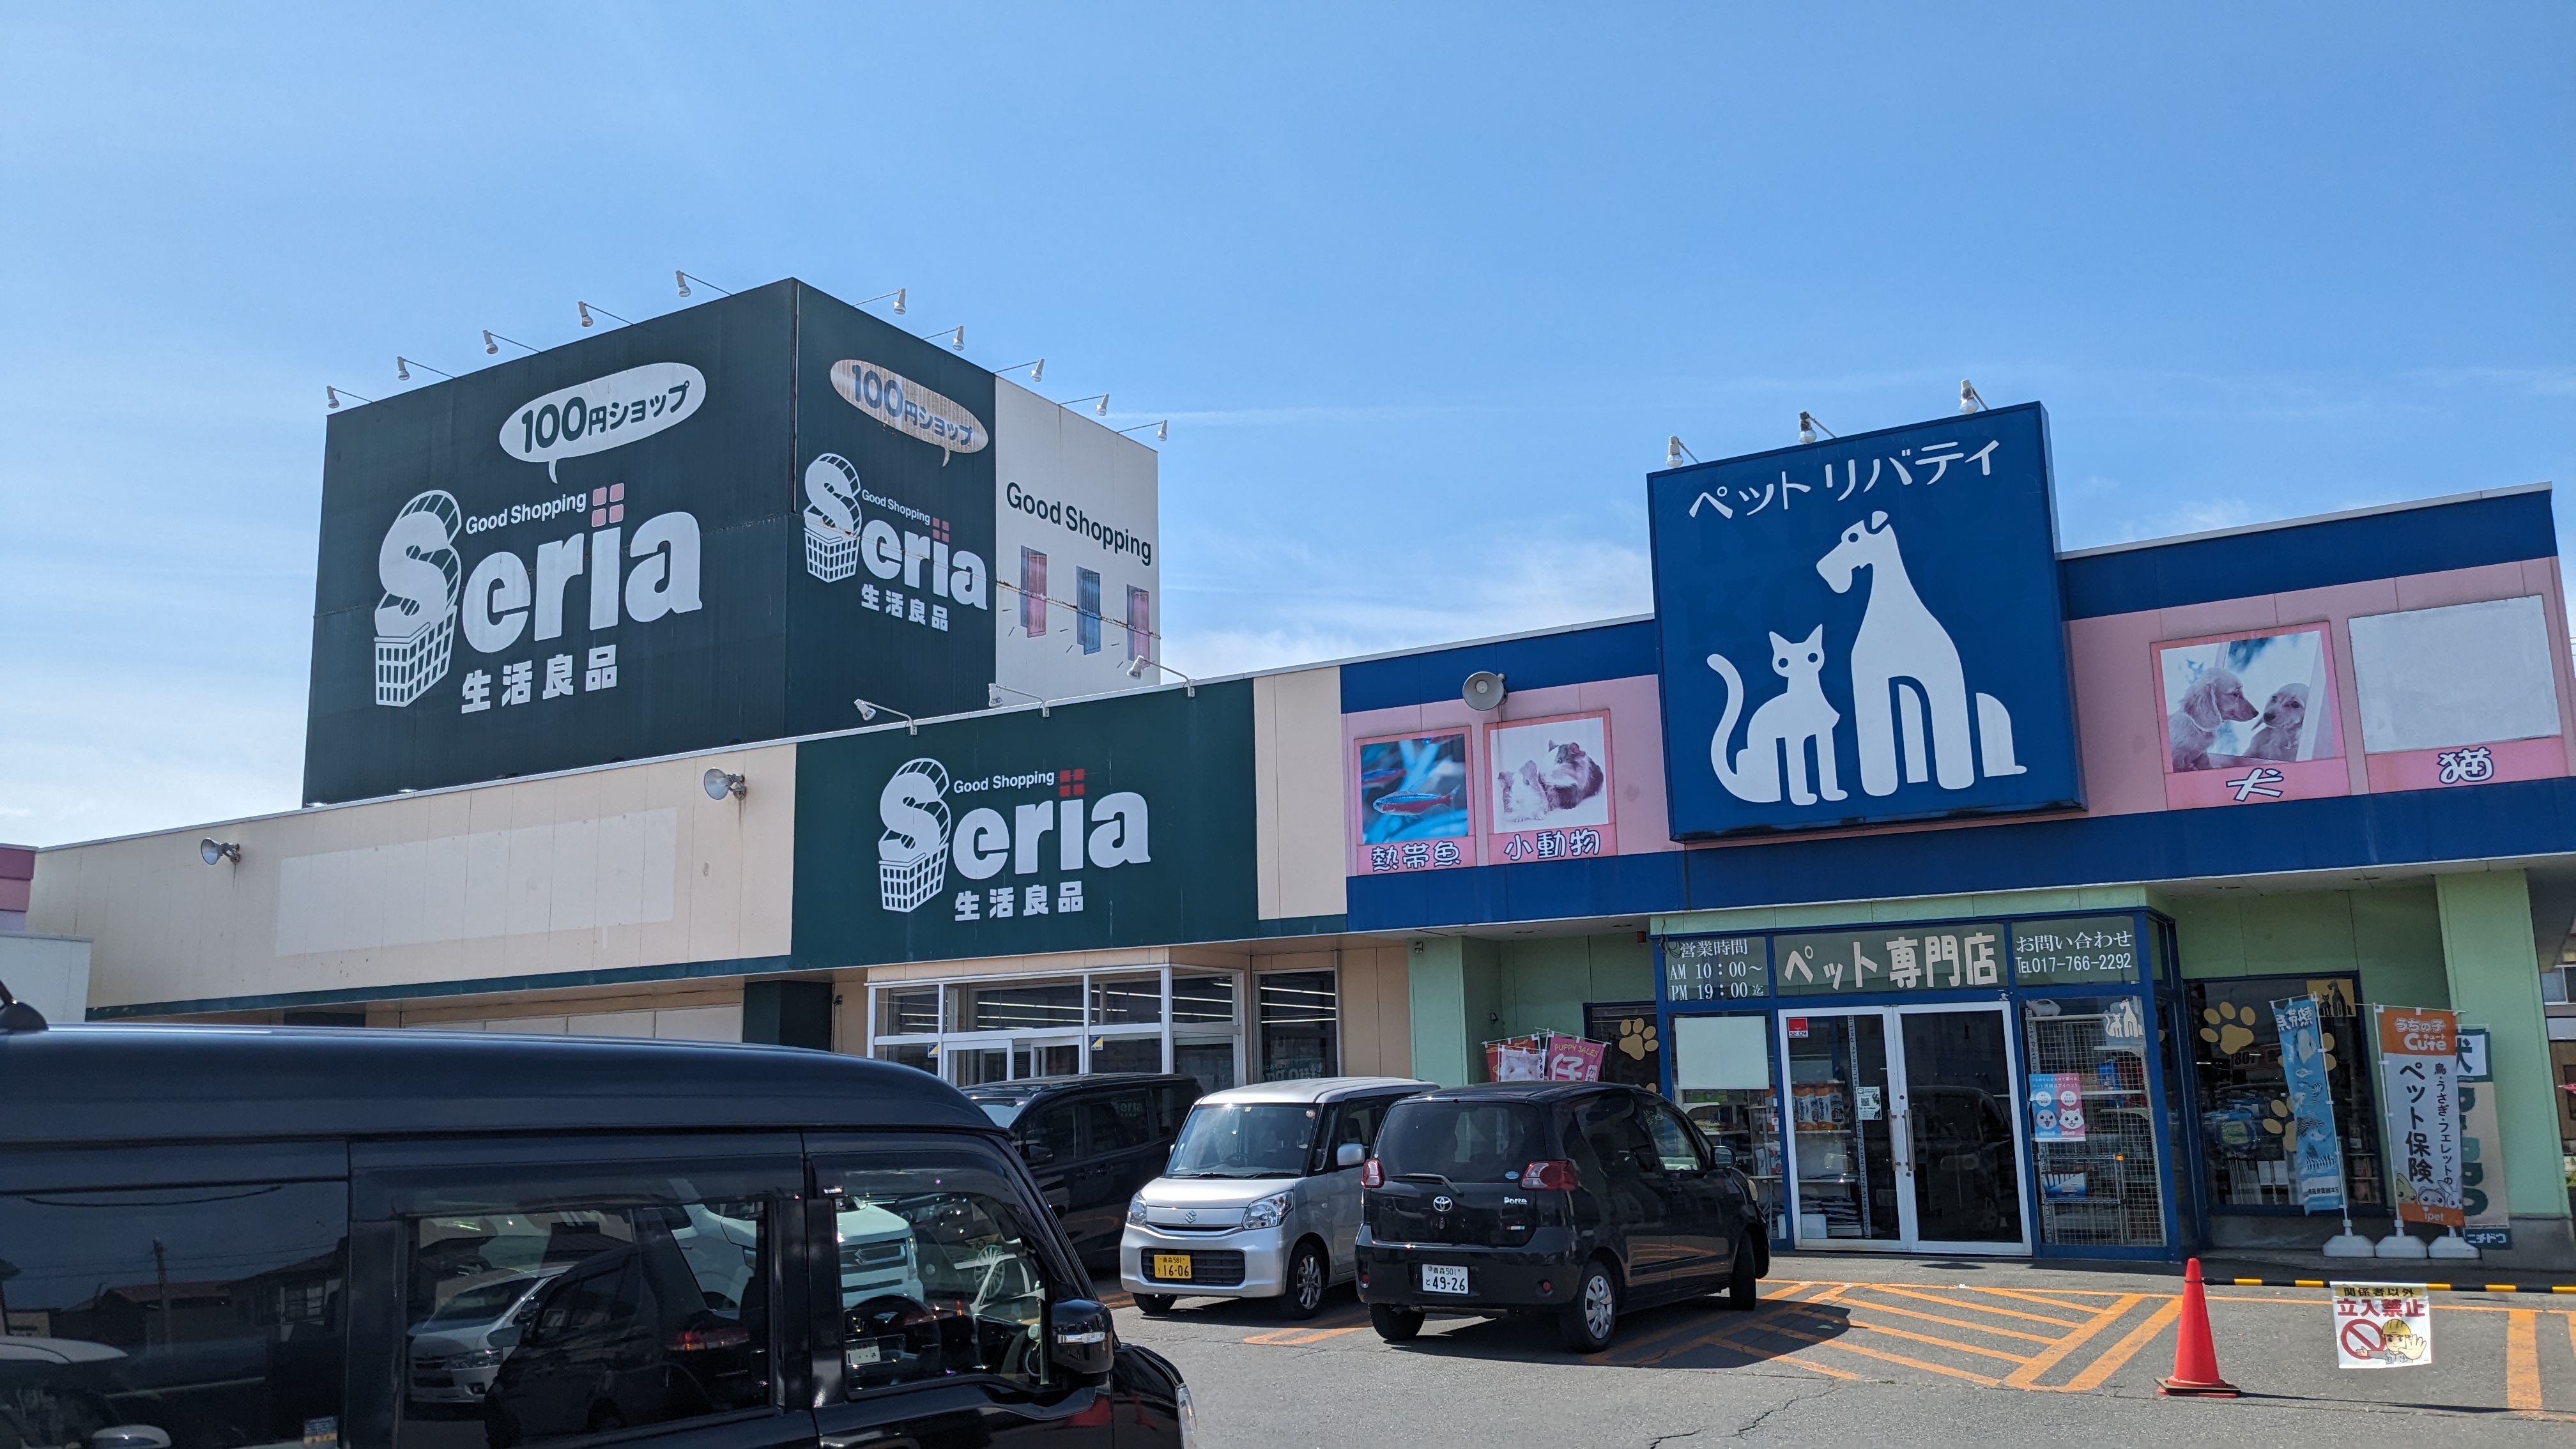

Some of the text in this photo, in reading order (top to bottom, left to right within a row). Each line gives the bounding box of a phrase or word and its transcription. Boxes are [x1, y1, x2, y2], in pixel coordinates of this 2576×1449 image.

[521, 380, 690, 452] 100円ショップ
[852, 364, 973, 446] 100円ショップ
[466, 491, 586, 534] Good Shopping
[862, 489, 930, 526] Good Shopping
[1007, 482, 1152, 566] Good Shopping
[804, 453, 988, 611] Seria
[374, 484, 702, 653] Seria
[861, 584, 948, 632] 生活良品
[461, 645, 617, 714] 生活良品
[954, 770, 1055, 793] Good Shopping
[2438, 747, 2494, 784] 猫
[2225, 768, 2284, 802] 犬
[878, 758, 1151, 880] Seria
[1372, 840, 1461, 872] 熱帯魚
[1504, 828, 1601, 861] 小動物
[954, 881, 1084, 921] 生活良品
[1681, 939, 1747, 958] 営業時間
[2016, 930, 2133, 953] お問い合わせ
[1670, 964, 1686, 981] AM
[1784, 932, 1998, 990] ペット専門店
[1672, 985, 1688, 1001] PM
[2395, 1017, 2446, 1032] うちの子
[2404, 1033, 2446, 1051] Cute
[2400, 1062, 2433, 1184] ペット保険
[1504, 1197, 1527, 1205] Porte
[2467, 1233, 2506, 1243] ニチドウ
[1164, 1265, 1189, 1276] 16-06
[1432, 1276, 1465, 1291] 49-26
[2337, 1298, 2425, 1317] 立入禁止
[2344, 1287, 2414, 1297] 関係者以外
